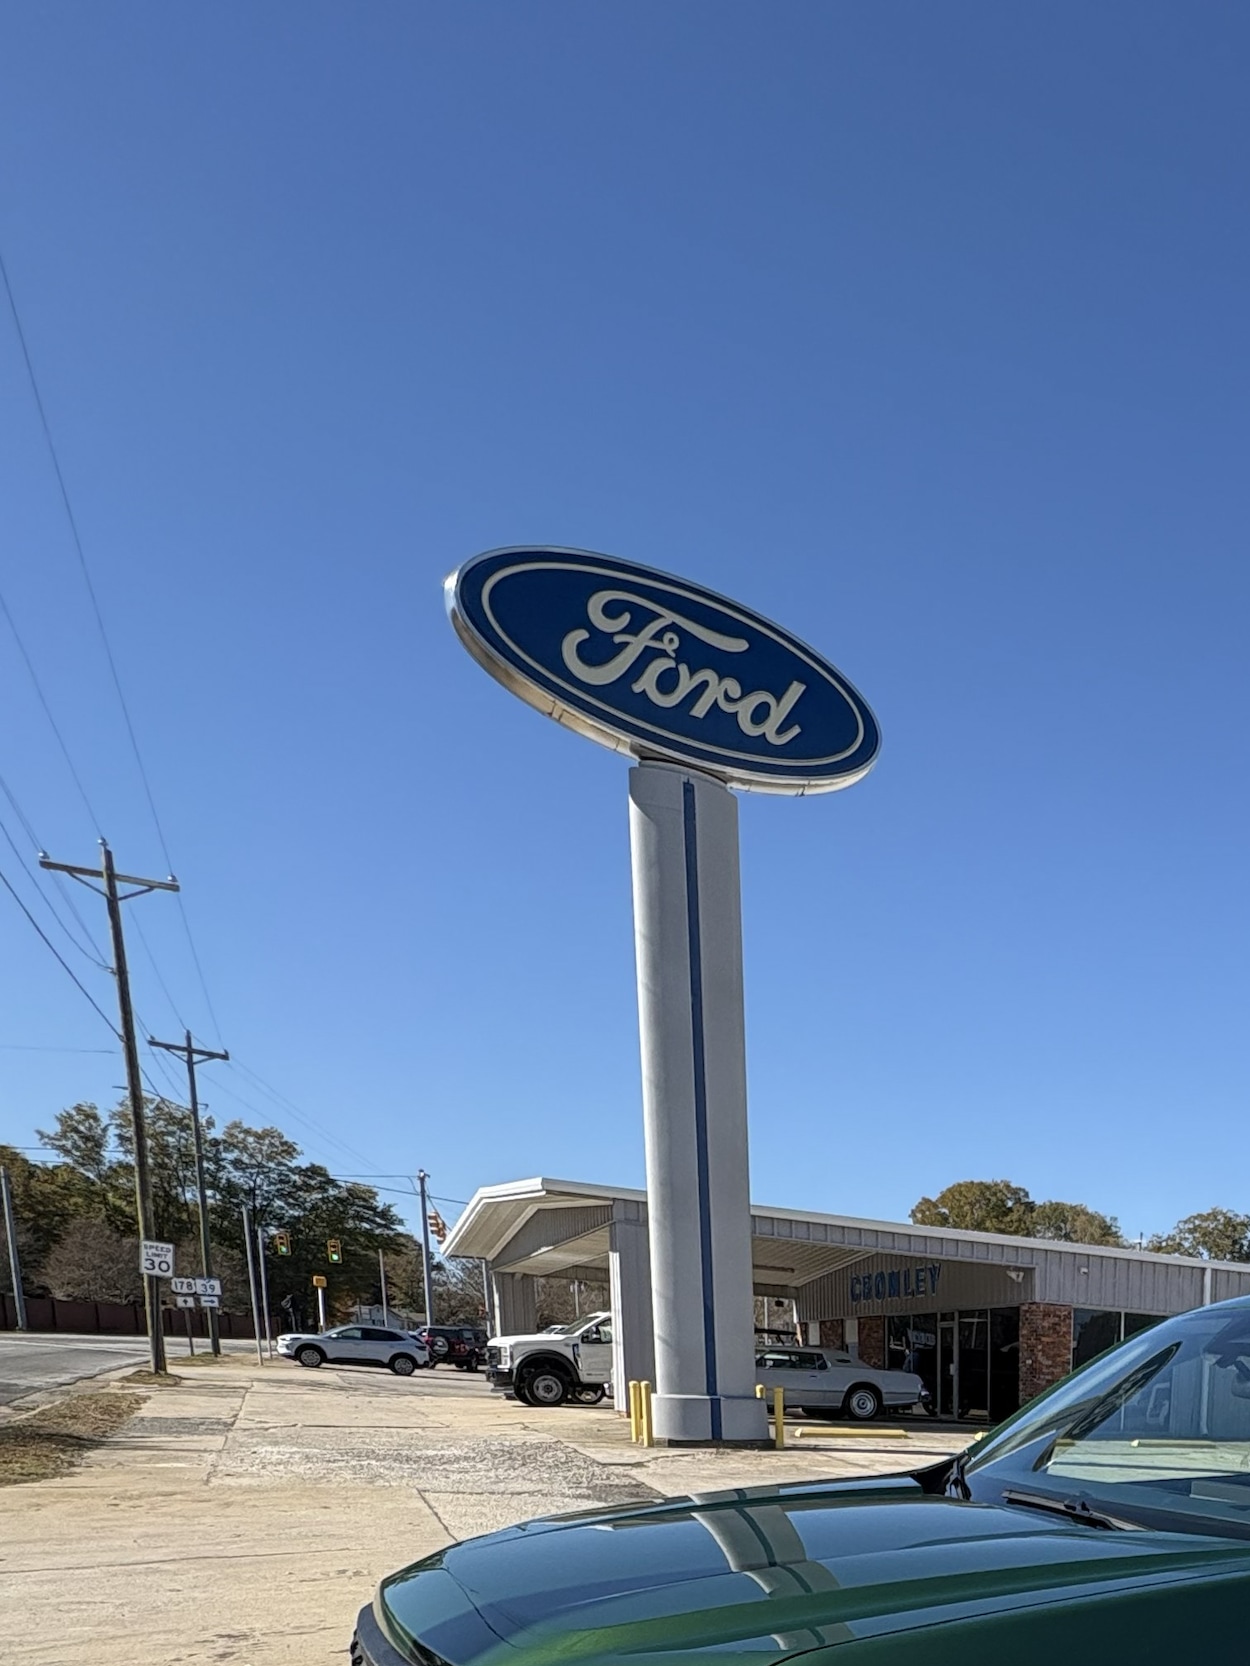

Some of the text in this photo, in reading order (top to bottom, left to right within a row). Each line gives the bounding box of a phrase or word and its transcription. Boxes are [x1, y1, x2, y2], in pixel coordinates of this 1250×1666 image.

[561, 590, 807, 746] Ford
[144, 1244, 171, 1253] SPEED
[144, 1258, 170, 1273] 30
[174, 1281, 193, 1291] 178
[201, 1283, 216, 1293] 39
